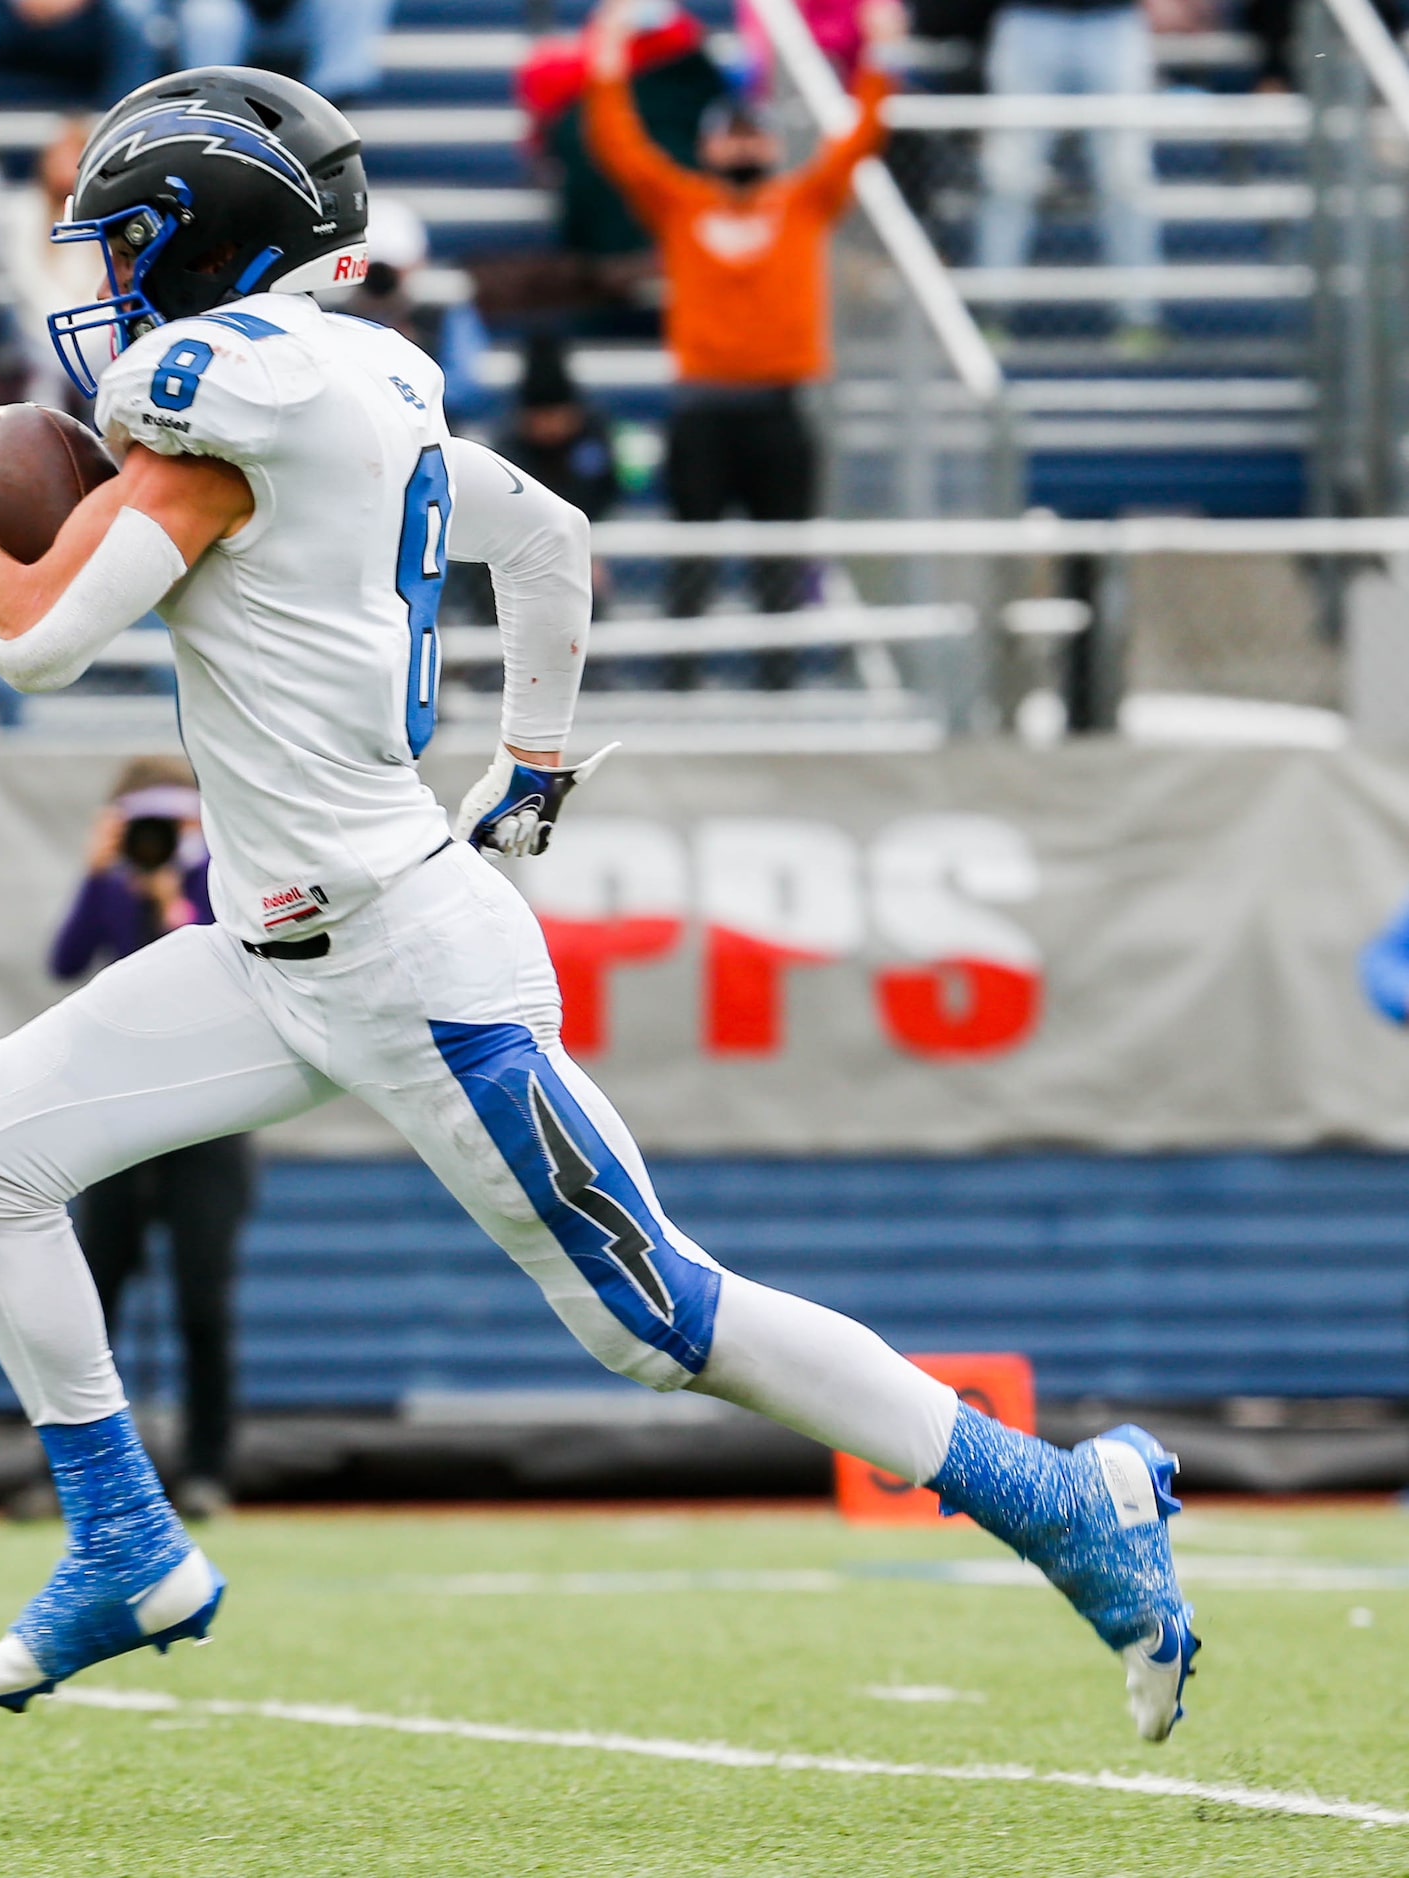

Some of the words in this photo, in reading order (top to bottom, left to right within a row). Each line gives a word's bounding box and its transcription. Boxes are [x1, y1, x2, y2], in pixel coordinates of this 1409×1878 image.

[150, 338, 214, 412] 8
[142, 413, 191, 433] Riddell
[396, 443, 452, 760] 8
